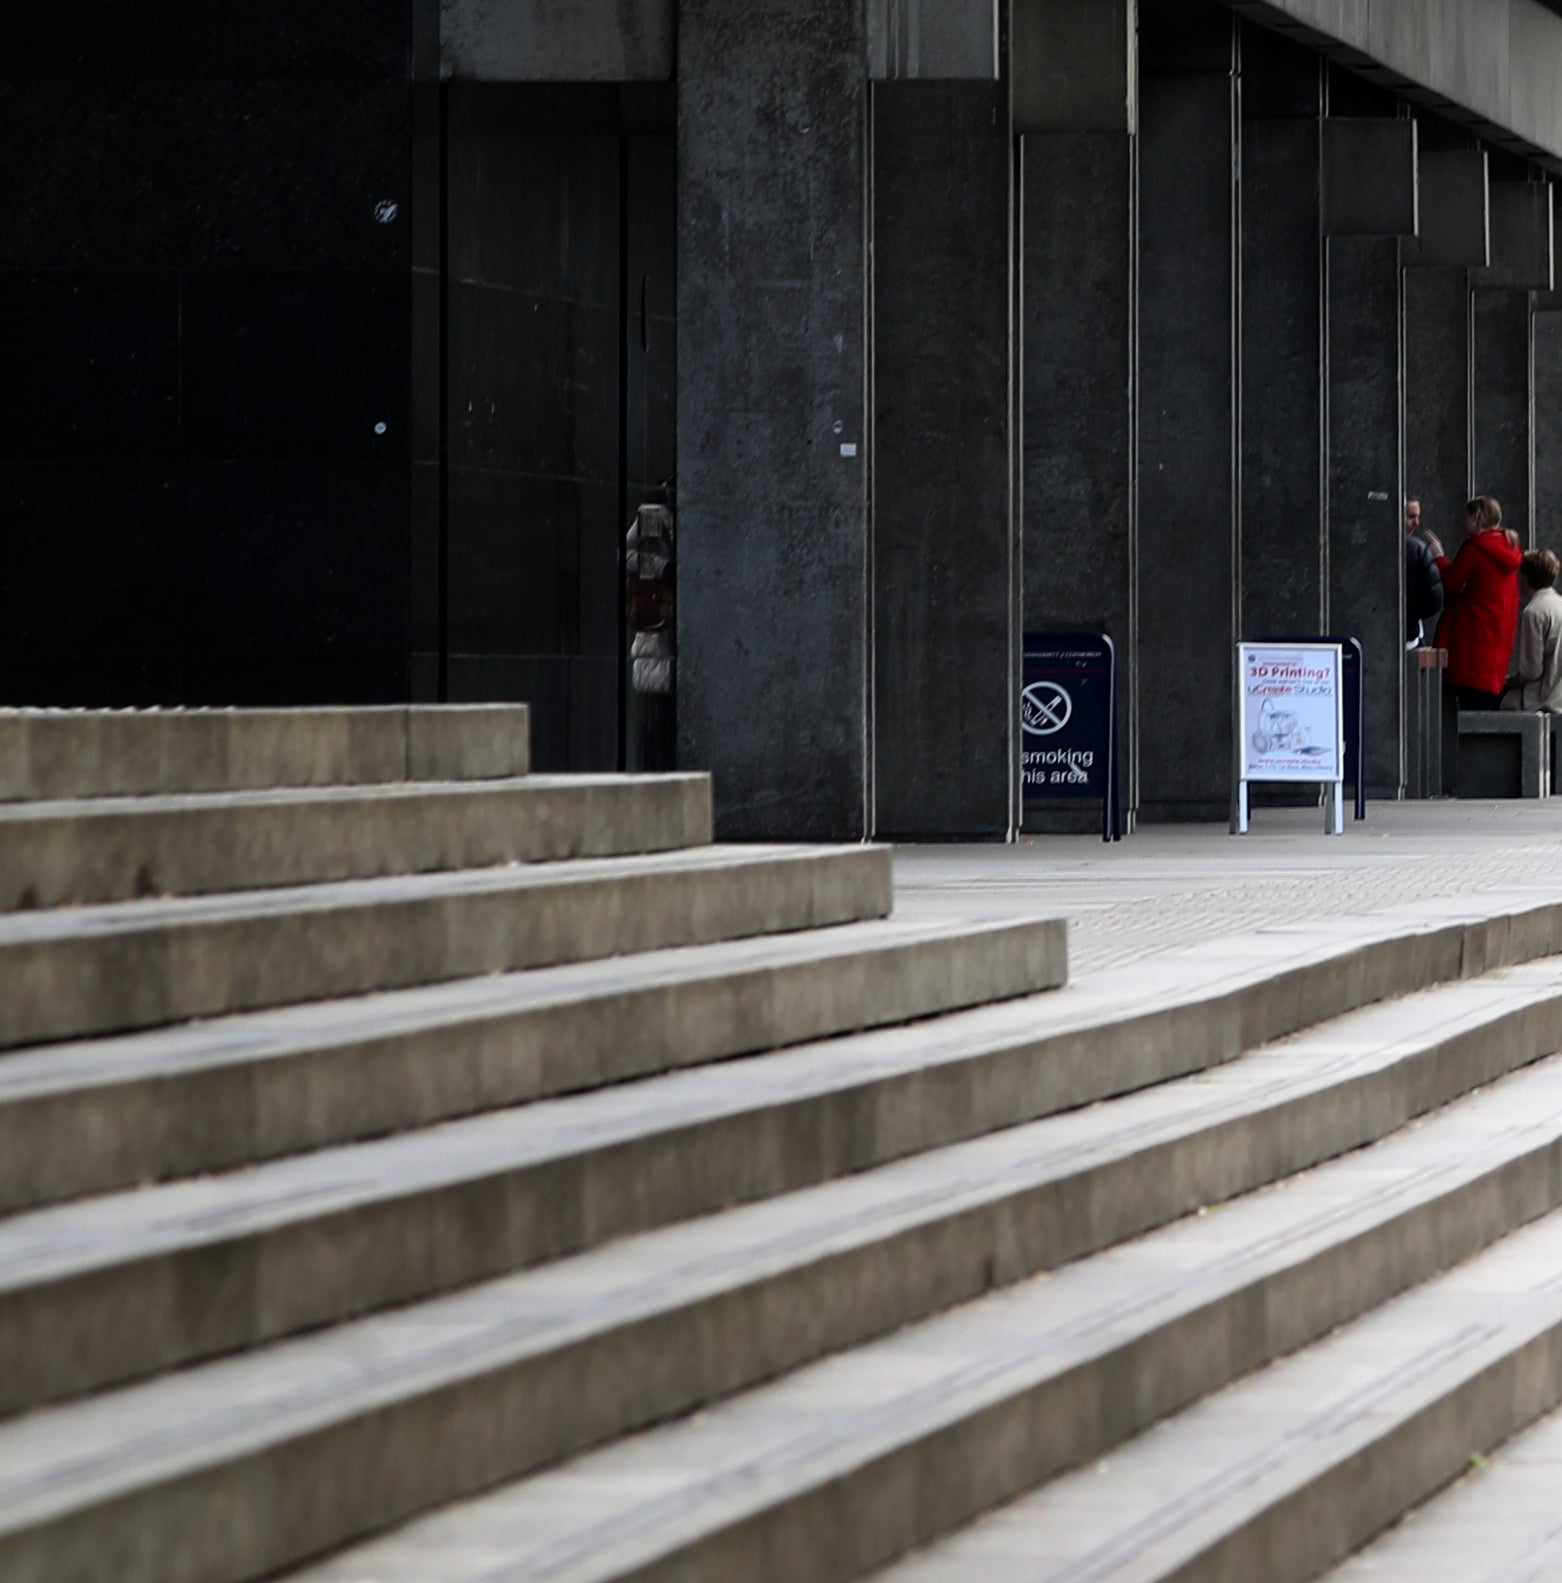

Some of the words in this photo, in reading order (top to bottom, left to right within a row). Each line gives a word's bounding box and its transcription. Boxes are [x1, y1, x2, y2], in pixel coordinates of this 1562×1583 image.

[1250, 666, 1268, 677] 3D
[1271, 665, 1331, 680] Printing?
[1022, 747, 1094, 767] smoking
[1022, 768, 1046, 784] his
[1049, 770, 1089, 784] area
